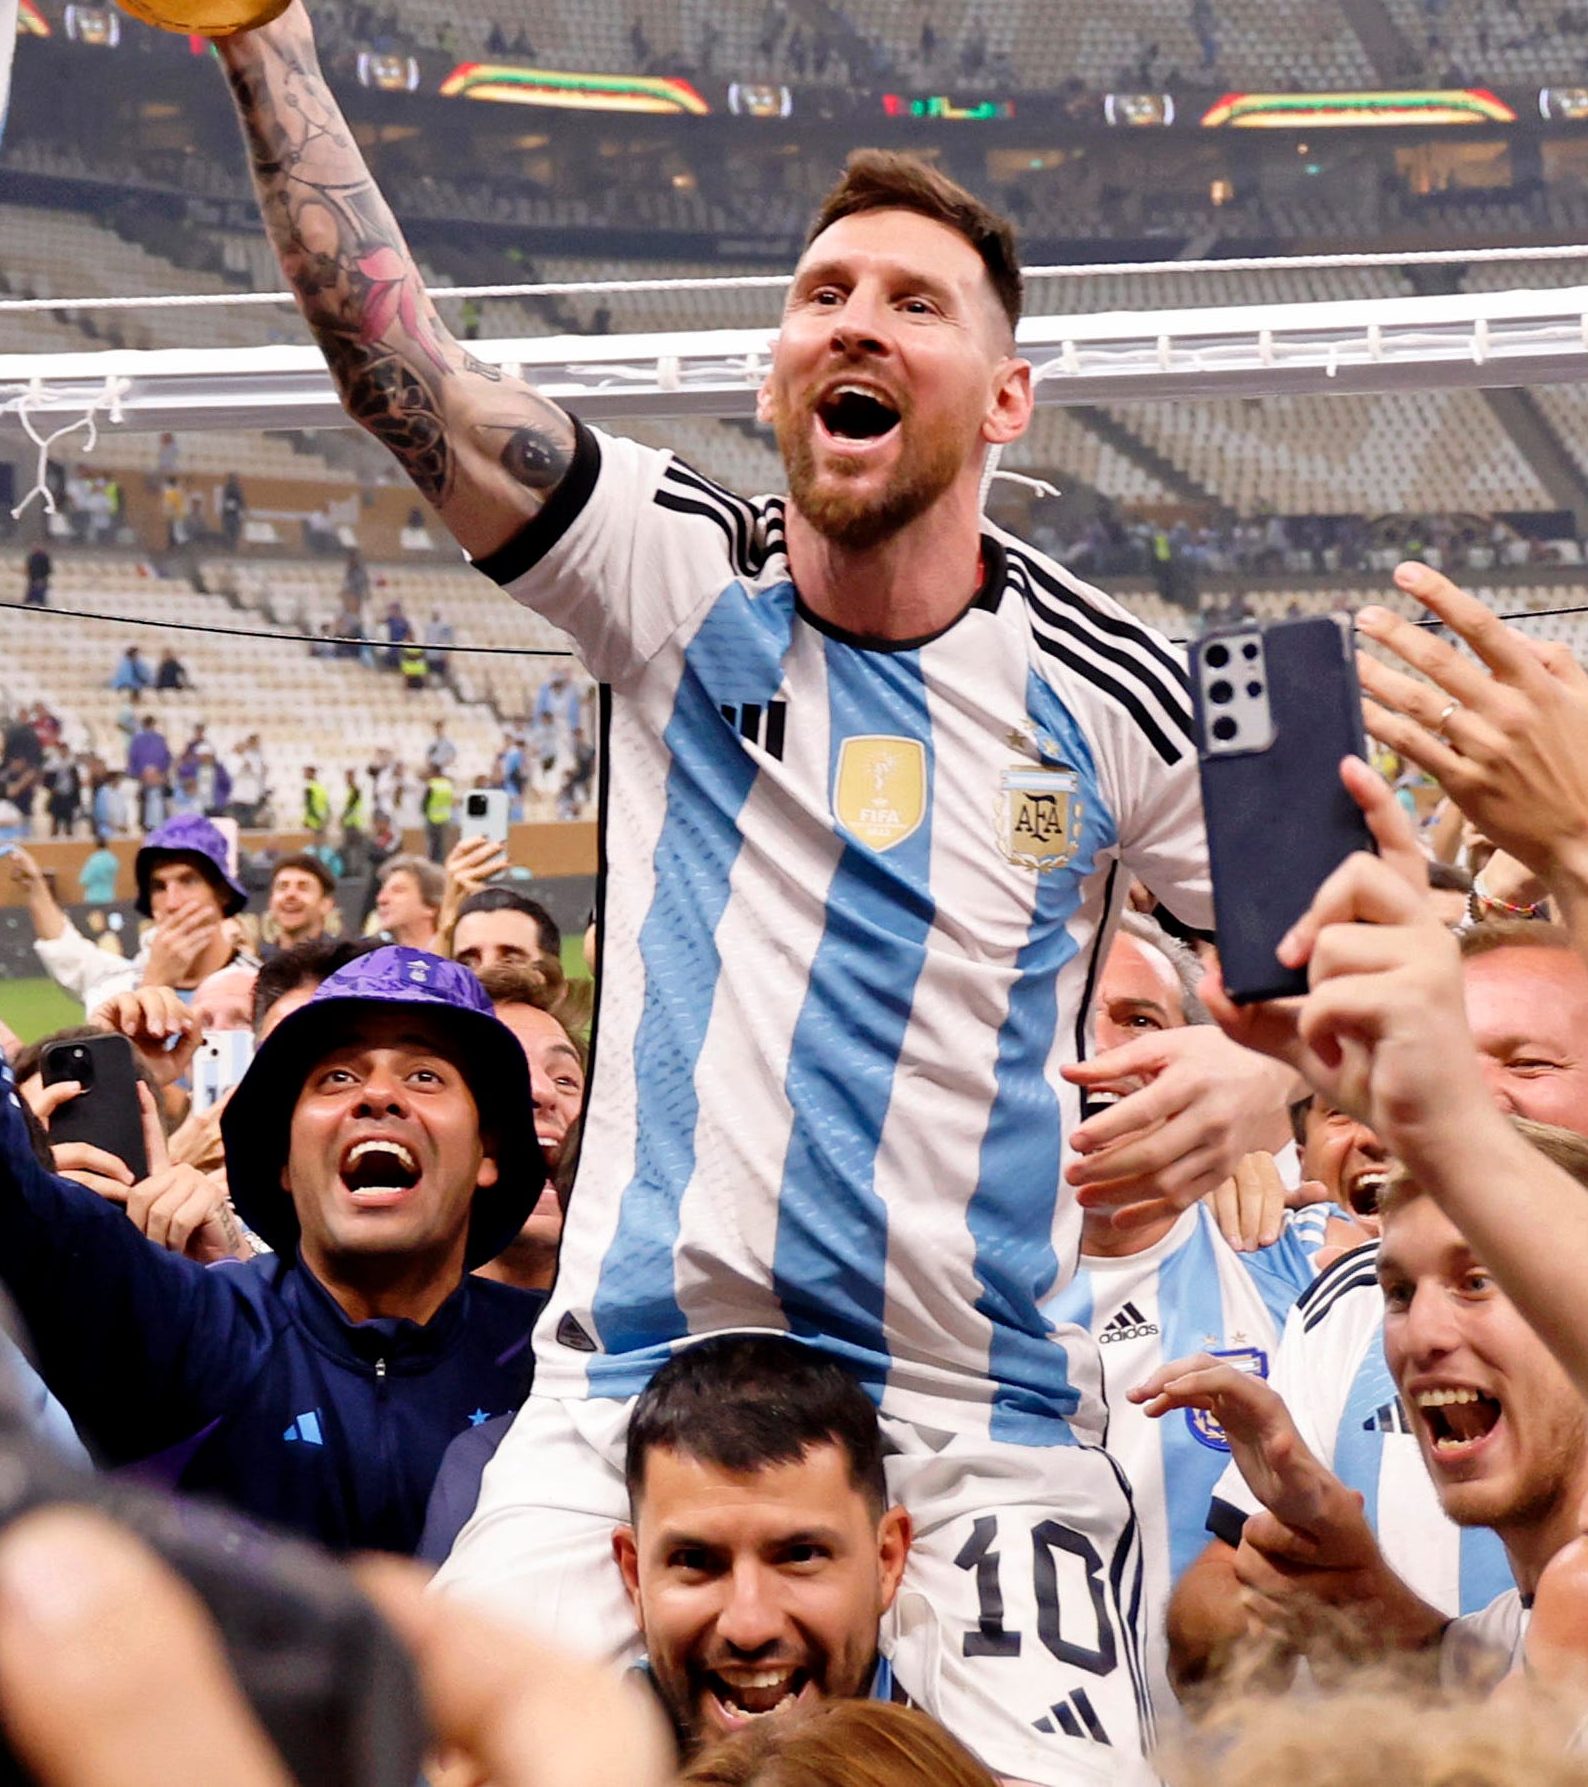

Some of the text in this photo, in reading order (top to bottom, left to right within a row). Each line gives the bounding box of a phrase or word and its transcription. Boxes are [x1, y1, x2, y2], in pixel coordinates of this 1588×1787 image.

[859, 807, 900, 825] FIFA
[1014, 792, 1063, 843] AFA
[1099, 1323, 1159, 1345] adidas
[954, 1516, 1118, 1677] 10
